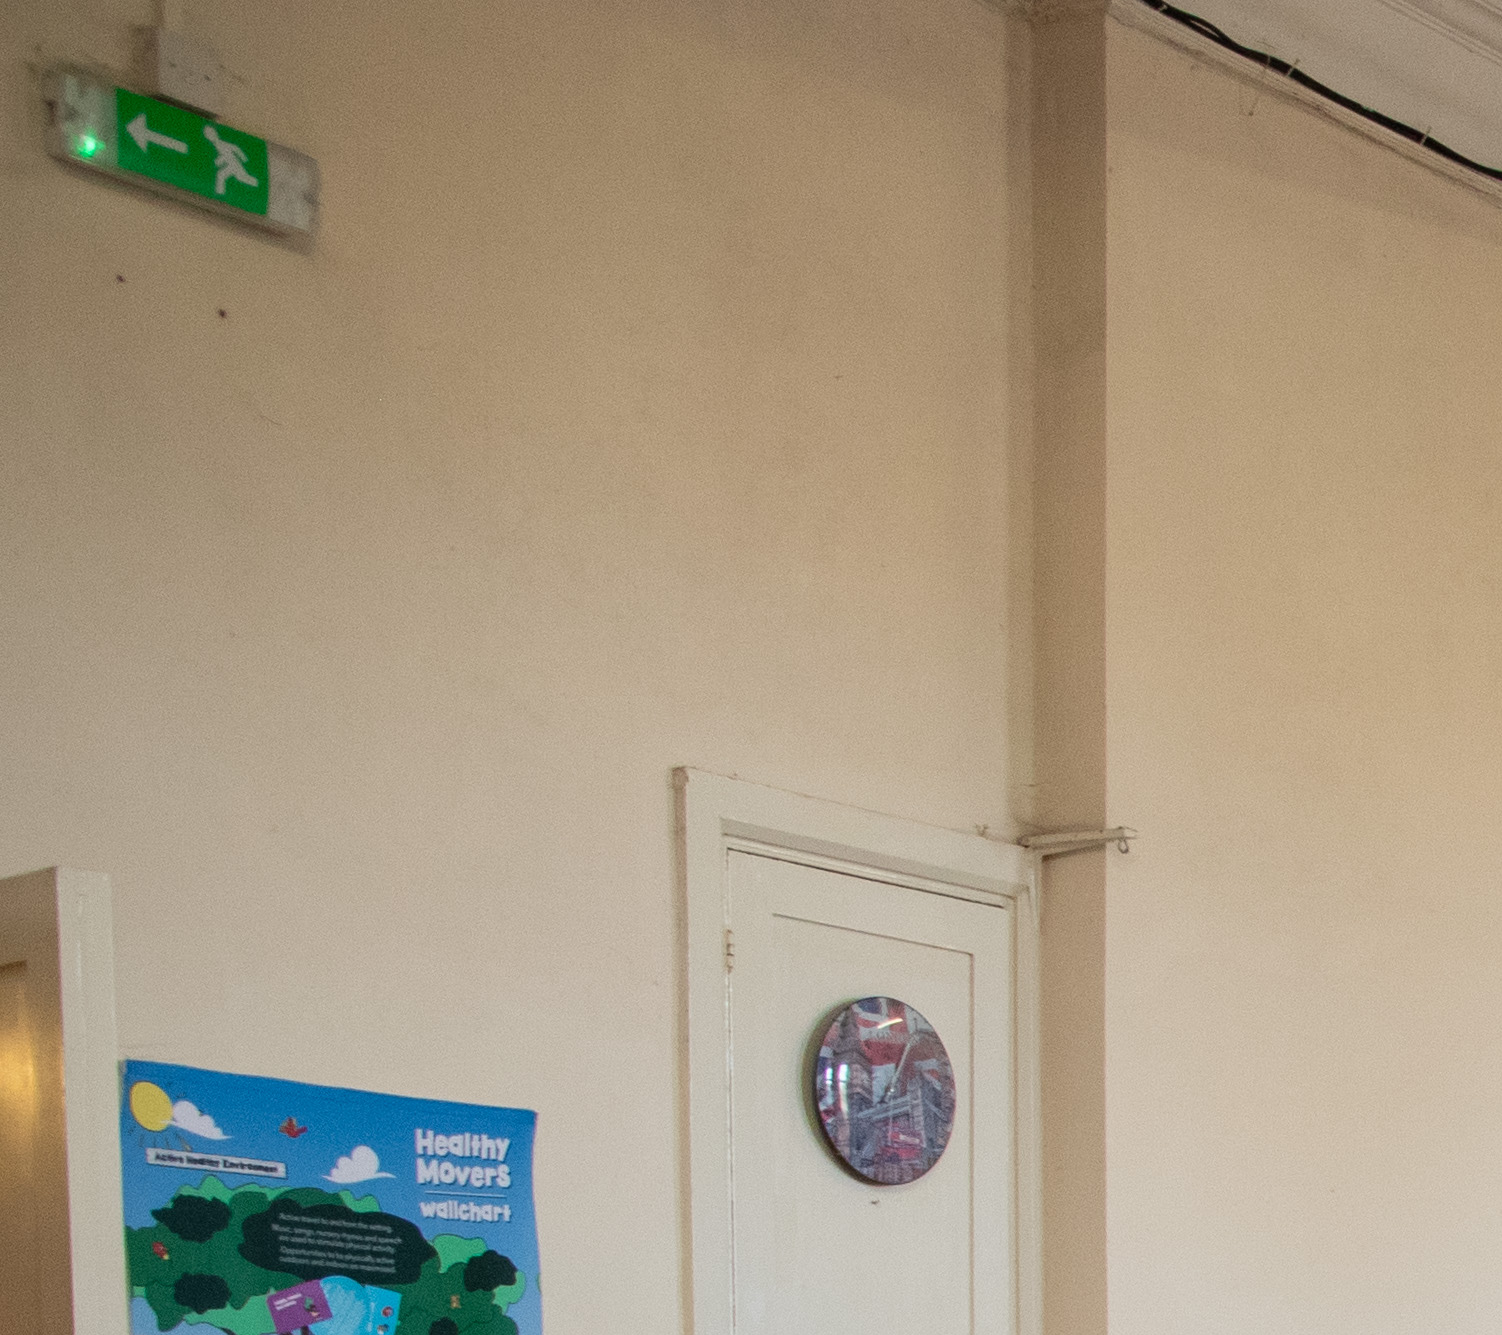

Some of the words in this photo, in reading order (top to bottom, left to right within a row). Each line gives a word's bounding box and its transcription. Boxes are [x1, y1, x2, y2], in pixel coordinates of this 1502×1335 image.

[414, 1128, 510, 1162] Healthy
[415, 1158, 511, 1188] Movers
[419, 1200, 511, 1222] wallchart
